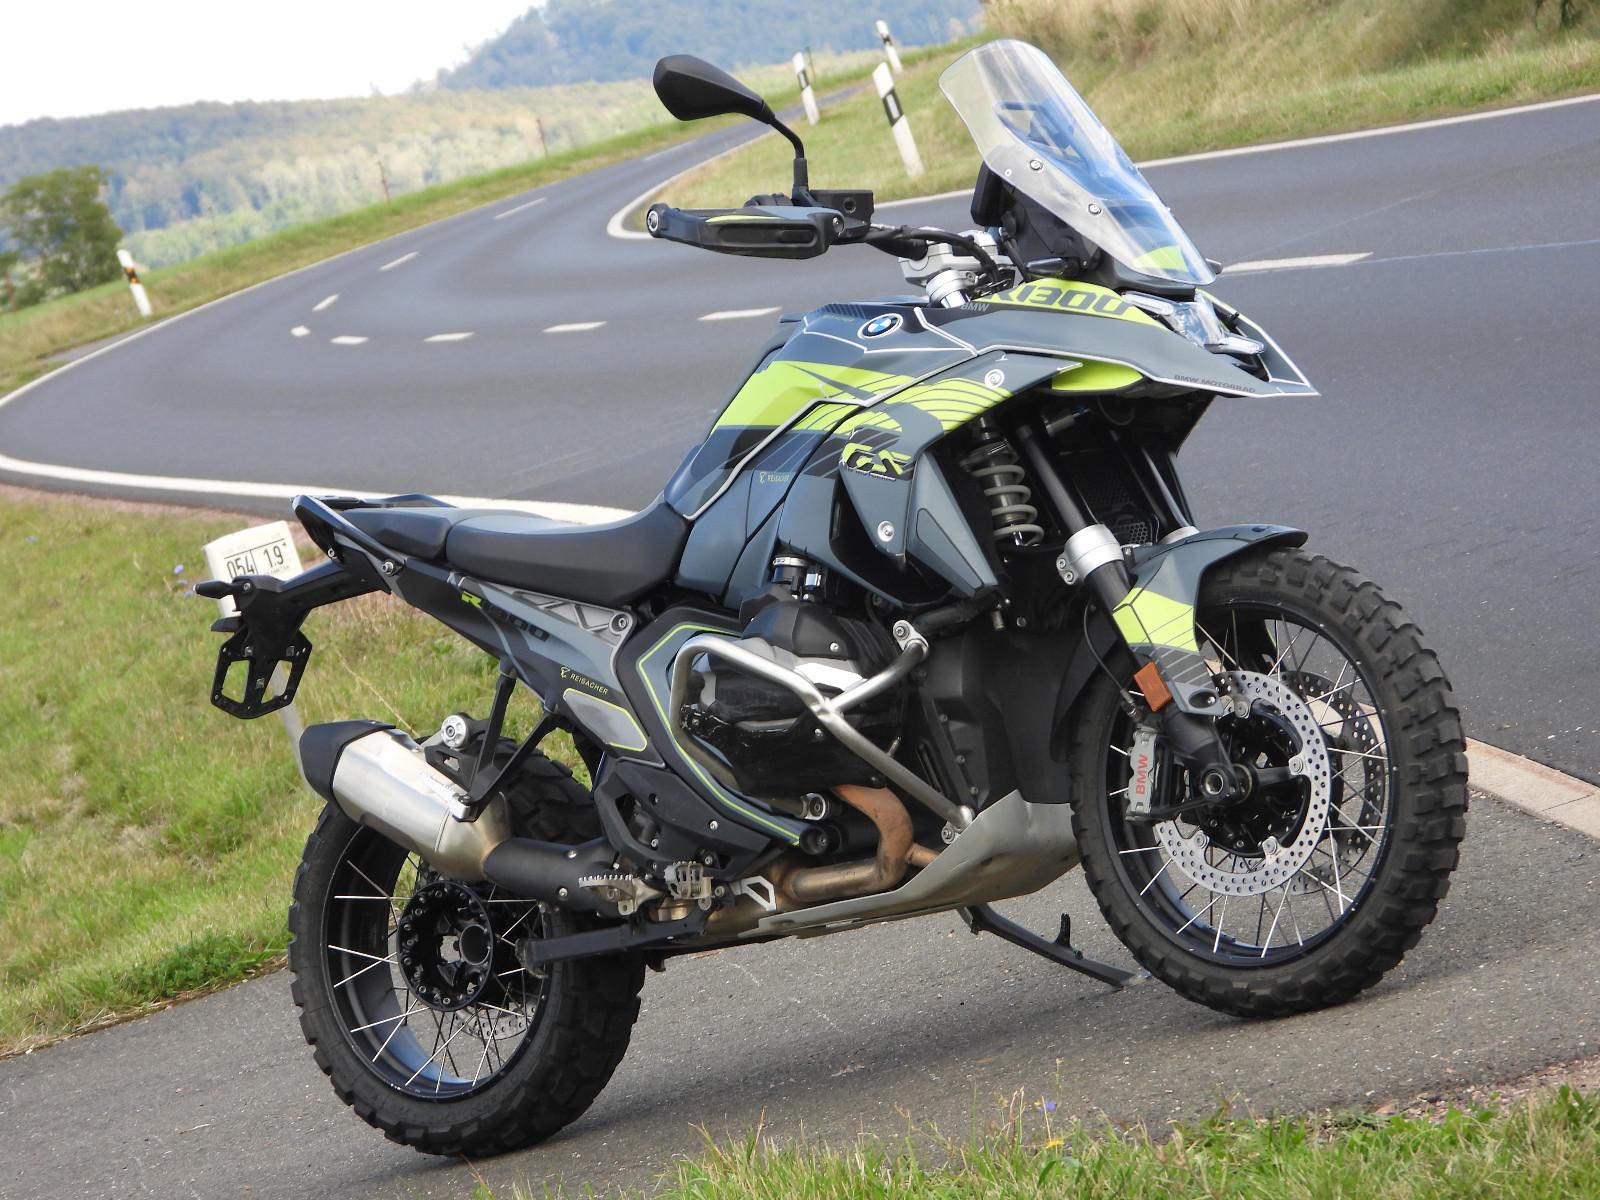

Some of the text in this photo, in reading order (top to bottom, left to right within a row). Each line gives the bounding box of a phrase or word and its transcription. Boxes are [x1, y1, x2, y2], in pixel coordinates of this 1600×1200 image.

[1174, 374, 1256, 393] BMW MOTORRAD
[841, 442, 912, 476] GS
[226, 555, 255, 579] 054
[570, 673, 609, 695] REISACHER
[1135, 753, 1149, 796] BMW
